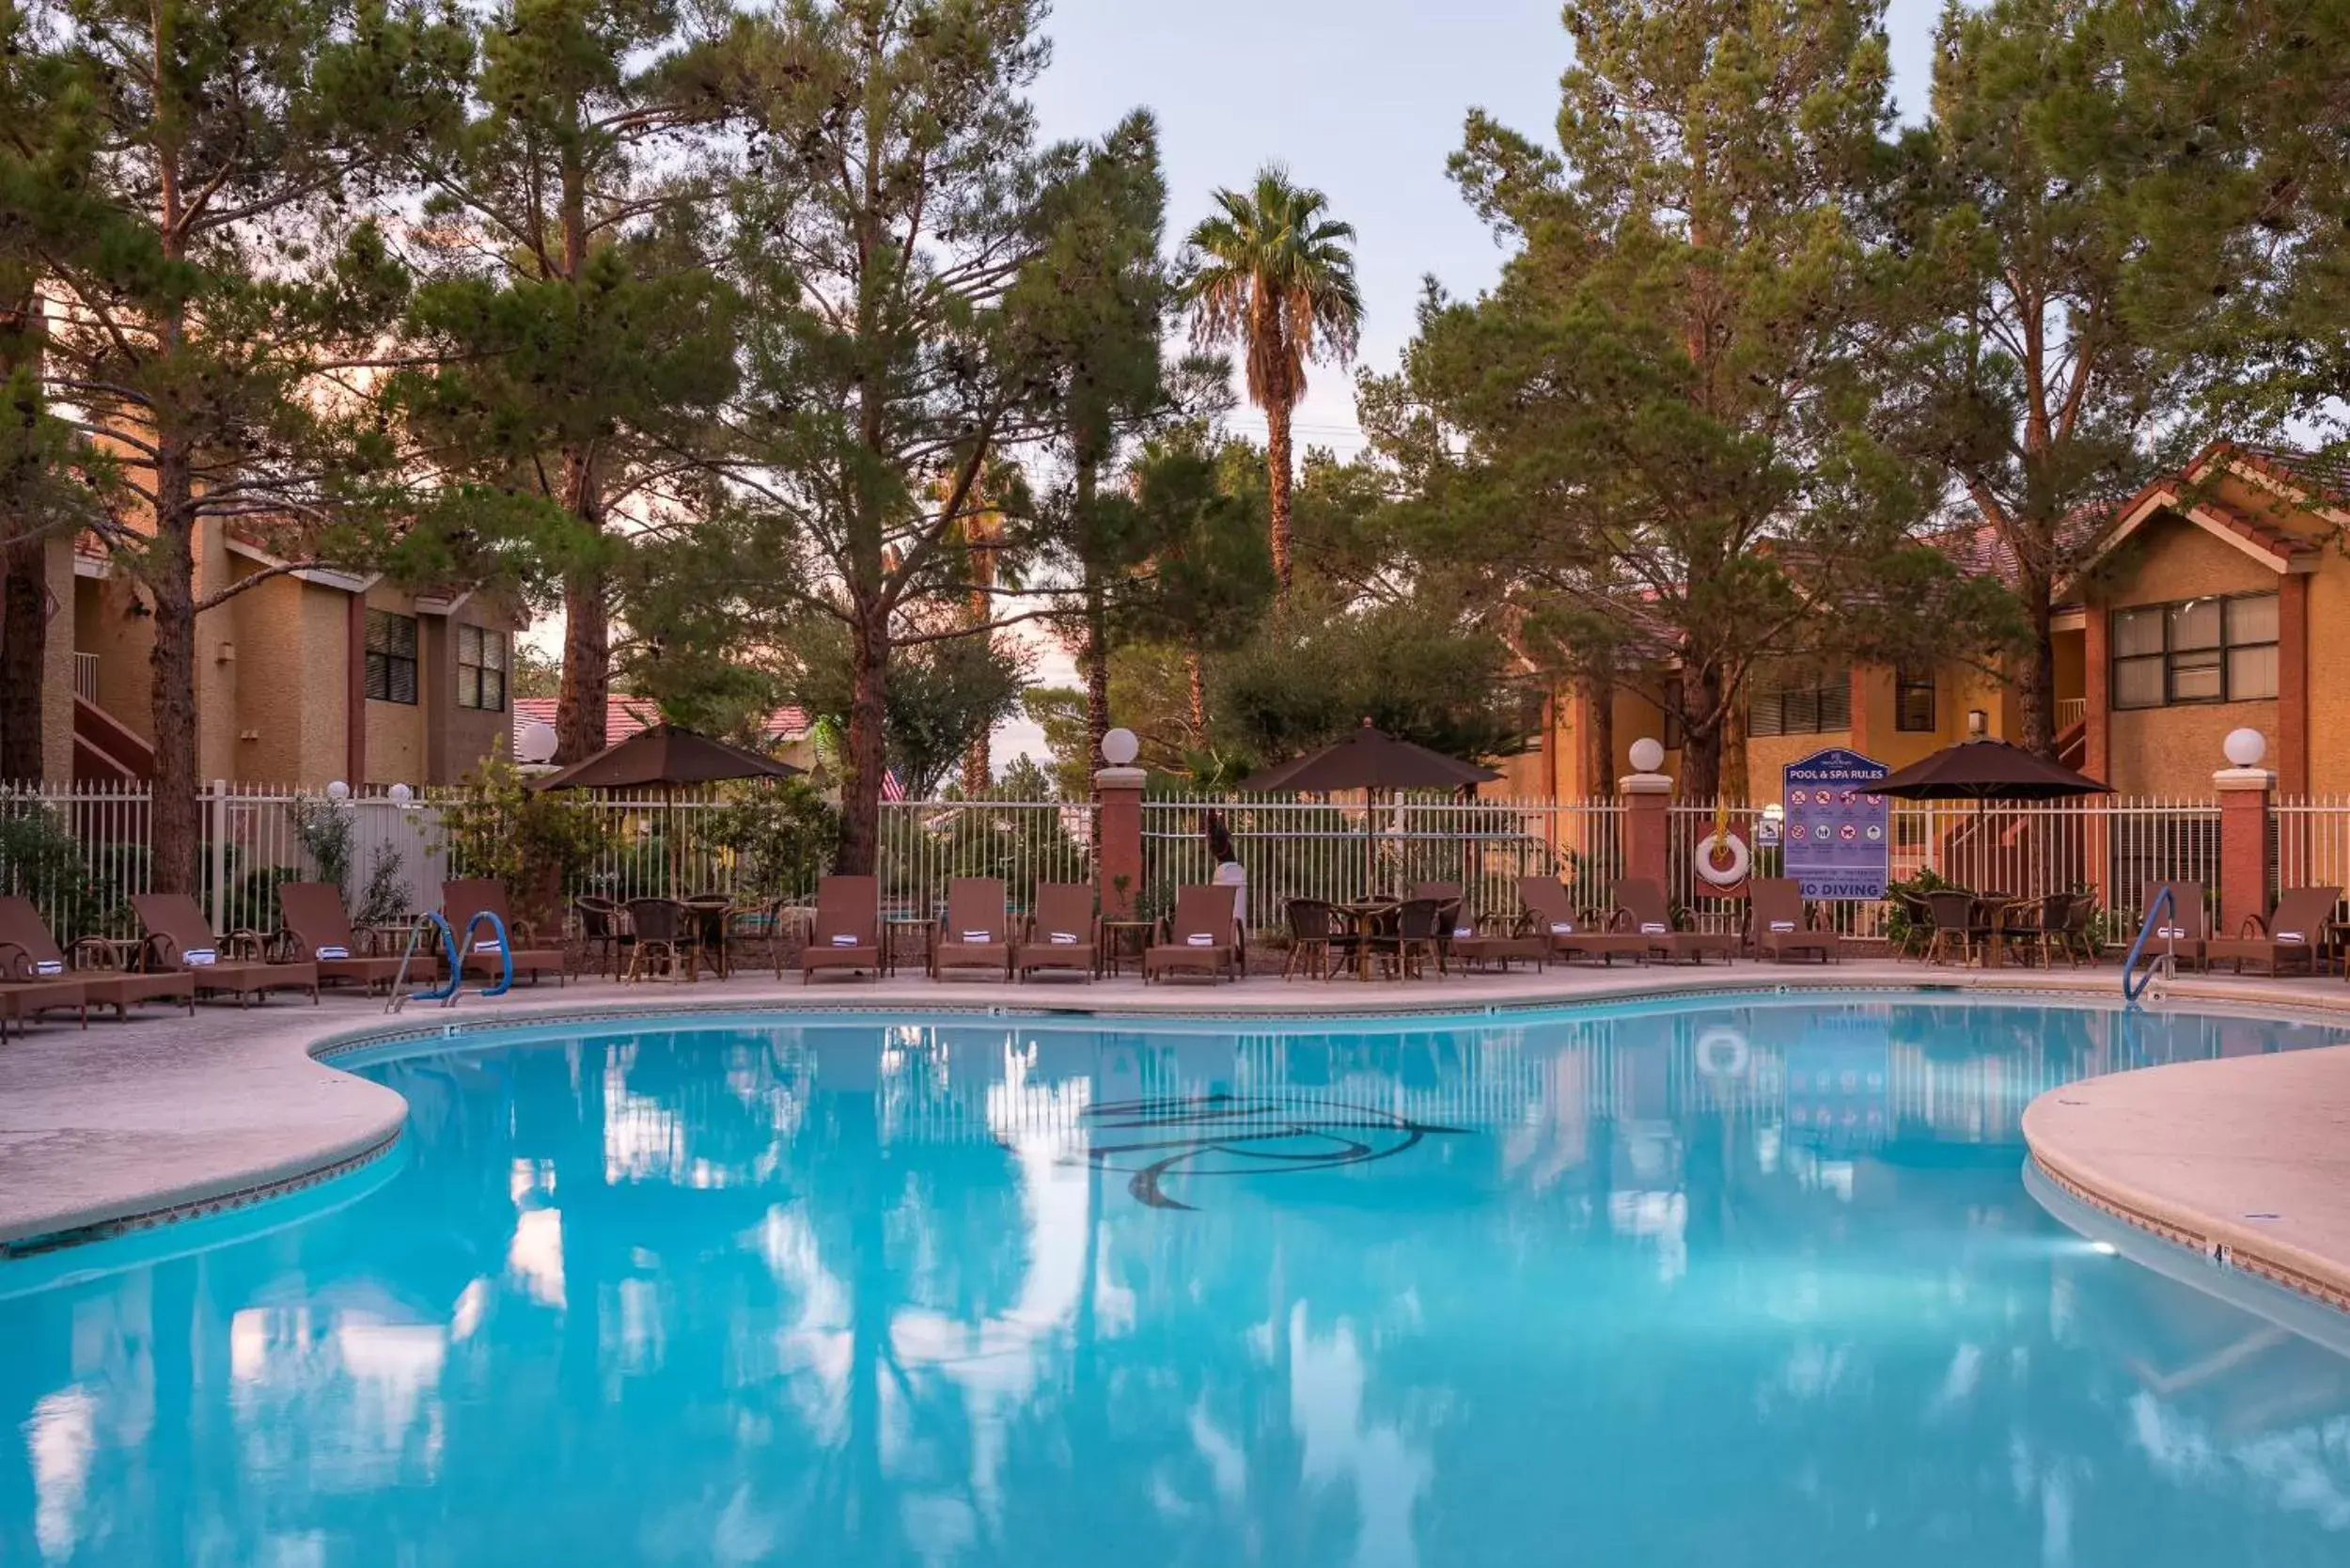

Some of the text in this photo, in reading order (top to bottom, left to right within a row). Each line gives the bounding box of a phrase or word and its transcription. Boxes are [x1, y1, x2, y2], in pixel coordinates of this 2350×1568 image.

[1790, 770, 1883, 779] POOL & SPA RULES
[1822, 884, 1878, 896] DIVING
